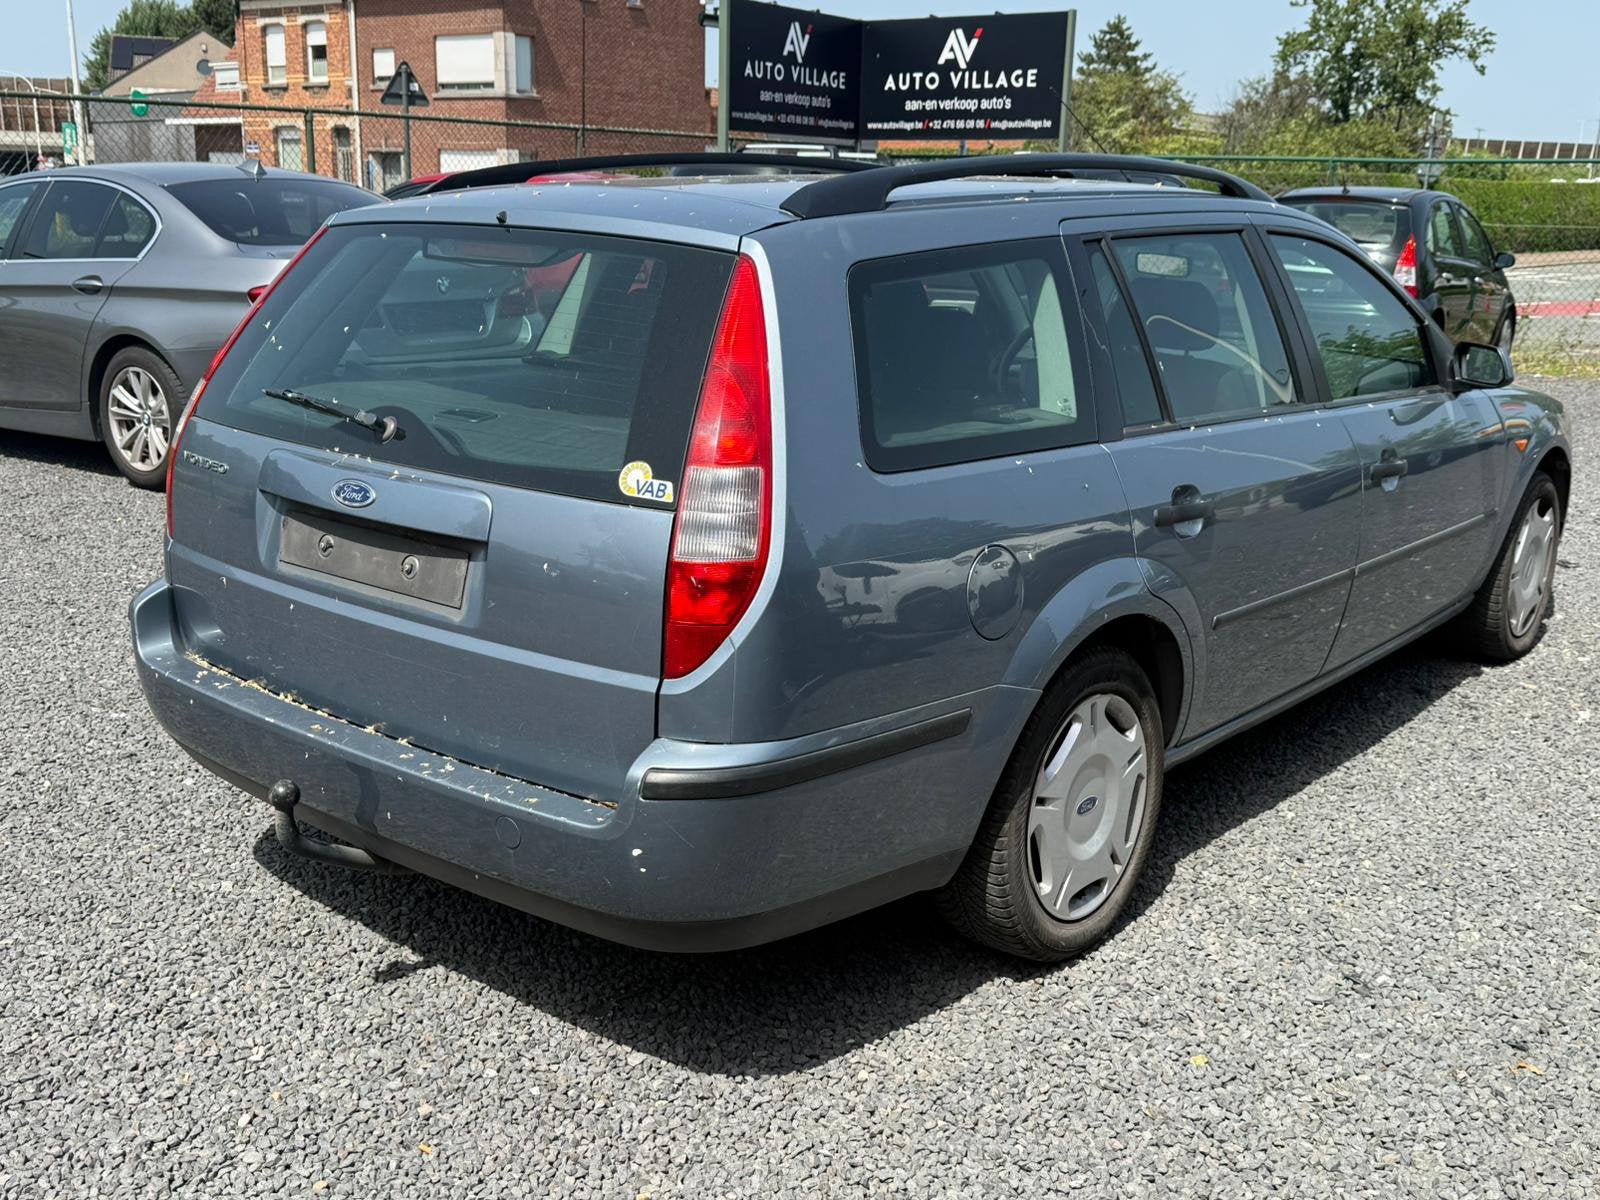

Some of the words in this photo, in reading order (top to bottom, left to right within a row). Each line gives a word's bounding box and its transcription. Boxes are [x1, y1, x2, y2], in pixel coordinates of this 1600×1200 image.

[744, 60, 785, 81] AUTO
[791, 65, 846, 89] VILLAGE
[884, 72, 940, 91] AUTO
[950, 69, 1038, 89] VILLAGE
[784, 92, 810, 108] verkoop
[811, 95, 831, 109] auto's
[905, 99, 937, 111] aan-en
[939, 97, 978, 112] verkoop
[980, 95, 1012, 110] auto's
[867, 120, 924, 131] www.autovillage.be
[340, 484, 367, 501] Ford
[636, 479, 667, 499] VAB
